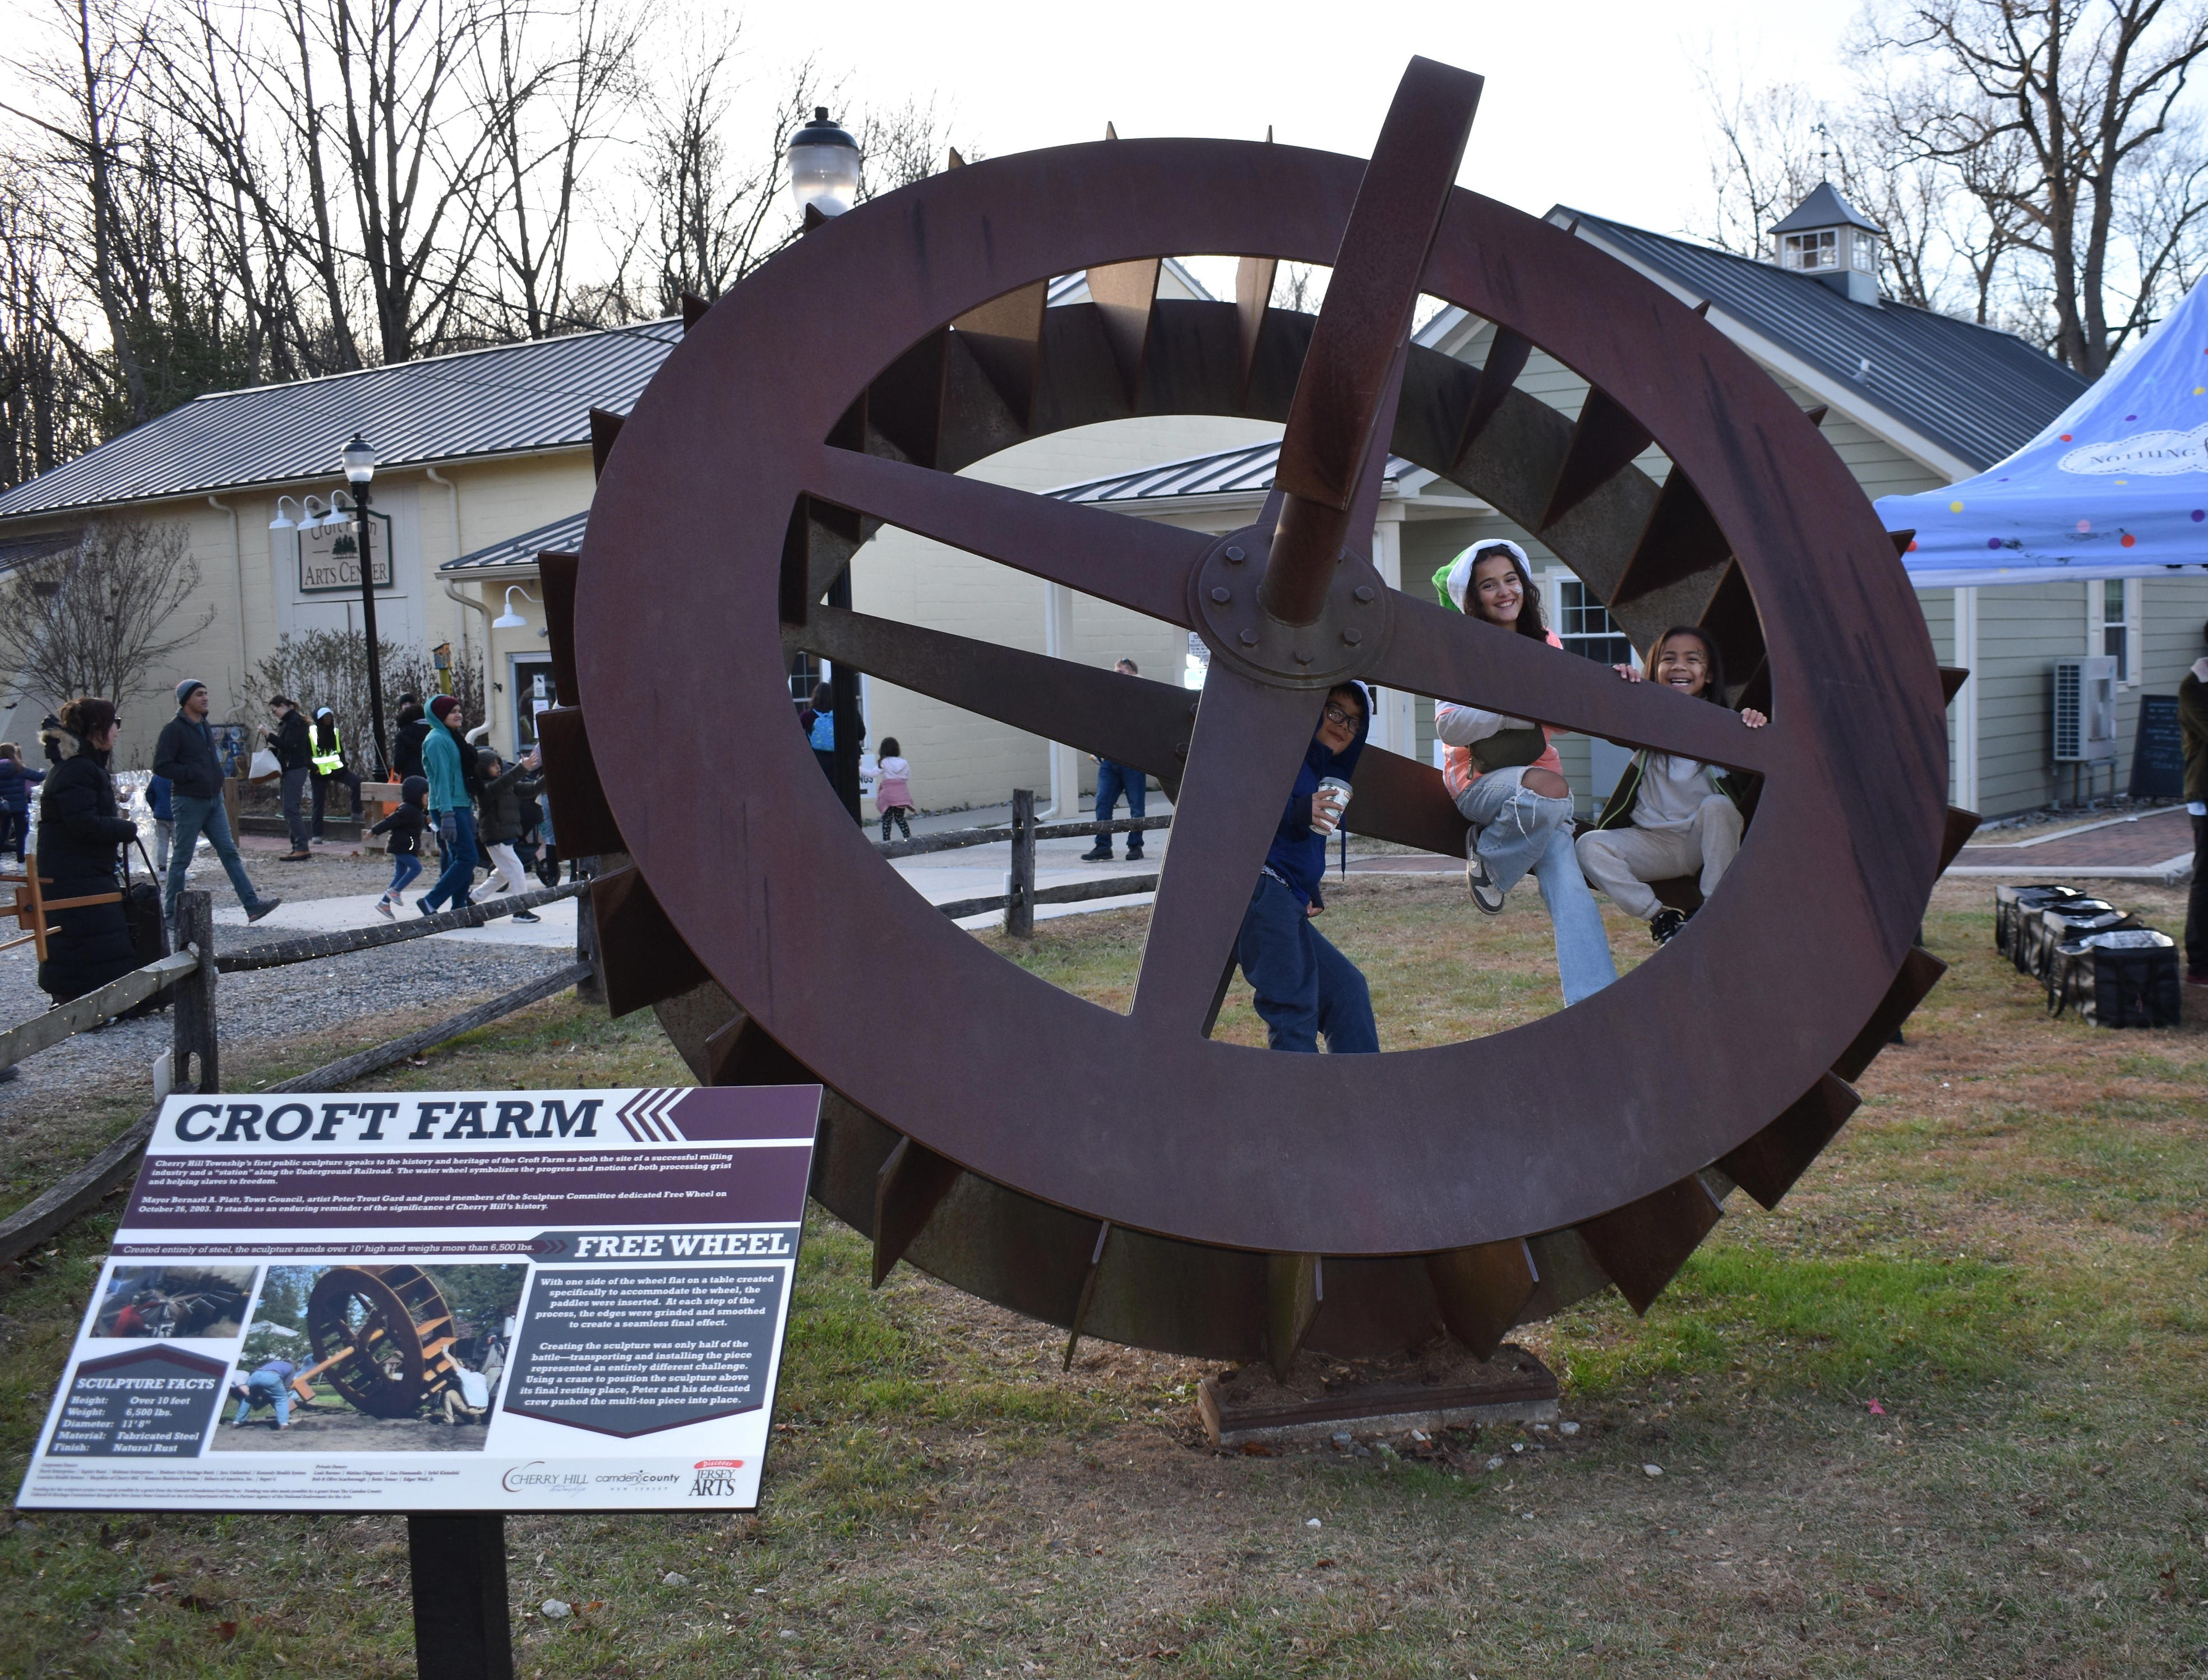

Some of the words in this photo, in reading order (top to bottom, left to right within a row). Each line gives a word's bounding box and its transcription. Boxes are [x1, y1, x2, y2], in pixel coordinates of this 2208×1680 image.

[2091, 449, 2196, 463] NOTHING
[305, 565, 336, 585] ARTS
[340, 561, 387, 583] CENER
[175, 1102, 400, 1142] CROFT
[409, 1099, 604, 1140] FARM
[155, 1160, 186, 1168] Cherry
[699, 1153, 733, 1161] milling
[254, 1166, 279, 1176] along
[295, 1166, 353, 1175] Underground
[415, 1165, 441, 1174] water
[469, 1164, 519, 1173] symbolizes
[659, 1162, 709, 1171] processing
[710, 1162, 732, 1170] grist
[165, 1178, 200, 1187] helping
[161, 1245, 197, 1255] entirely
[251, 1245, 294, 1254] sculpture
[364, 1244, 386, 1254] high
[407, 1244, 441, 1254] weighs
[490, 1243, 516, 1252] 6,500
[575, 1235, 665, 1258] FREE
[669, 1233, 791, 1257] WHEEL
[709, 1275, 735, 1284] table
[736, 1275, 774, 1283] created
[549, 1288, 607, 1298] specifically
[620, 1287, 690, 1295] accommodate
[709, 1286, 742, 1295] wheel,
[744, 1285, 761, 1294] the
[549, 1299, 589, 1309] paddles
[617, 1298, 662, 1306] inserted.
[665, 1297, 677, 1305] At
[704, 1298, 726, 1307] step
[534, 1311, 576, 1319] process,
[597, 1309, 626, 1319] edges
[654, 1308, 694, 1318] grinded
[717, 1307, 766, 1315] smoothed
[622, 1319, 669, 1327] seamless
[670, 1318, 695, 1327] final
[77, 1378, 166, 1389] SCULPTURE
[167, 1378, 216, 1389] FACTS
[71, 1396, 108, 1406] Height:
[130, 1396, 156, 1404] Over
[157, 1396, 169, 1405] 10
[170, 1396, 191, 1405] feet
[67, 1407, 105, 1418] Weight:
[125, 1407, 153, 1417] 6,500
[62, 1419, 114, 1428] Diameter:
[58, 1431, 107, 1439] Material:
[117, 1431, 173, 1440] Fabricated
[173, 1432, 200, 1440] Steel
[53, 1443, 90, 1451] Finish:
[112, 1443, 153, 1452] Natural
[153, 1443, 178, 1452] Rust
[511, 1474, 560, 1484] CHERRY
[563, 1474, 589, 1484] HILL
[596, 1474, 639, 1482] camden
[643, 1474, 680, 1483] county
[697, 1469, 736, 1479] JERSEY
[688, 1478, 736, 1497] ARTS
